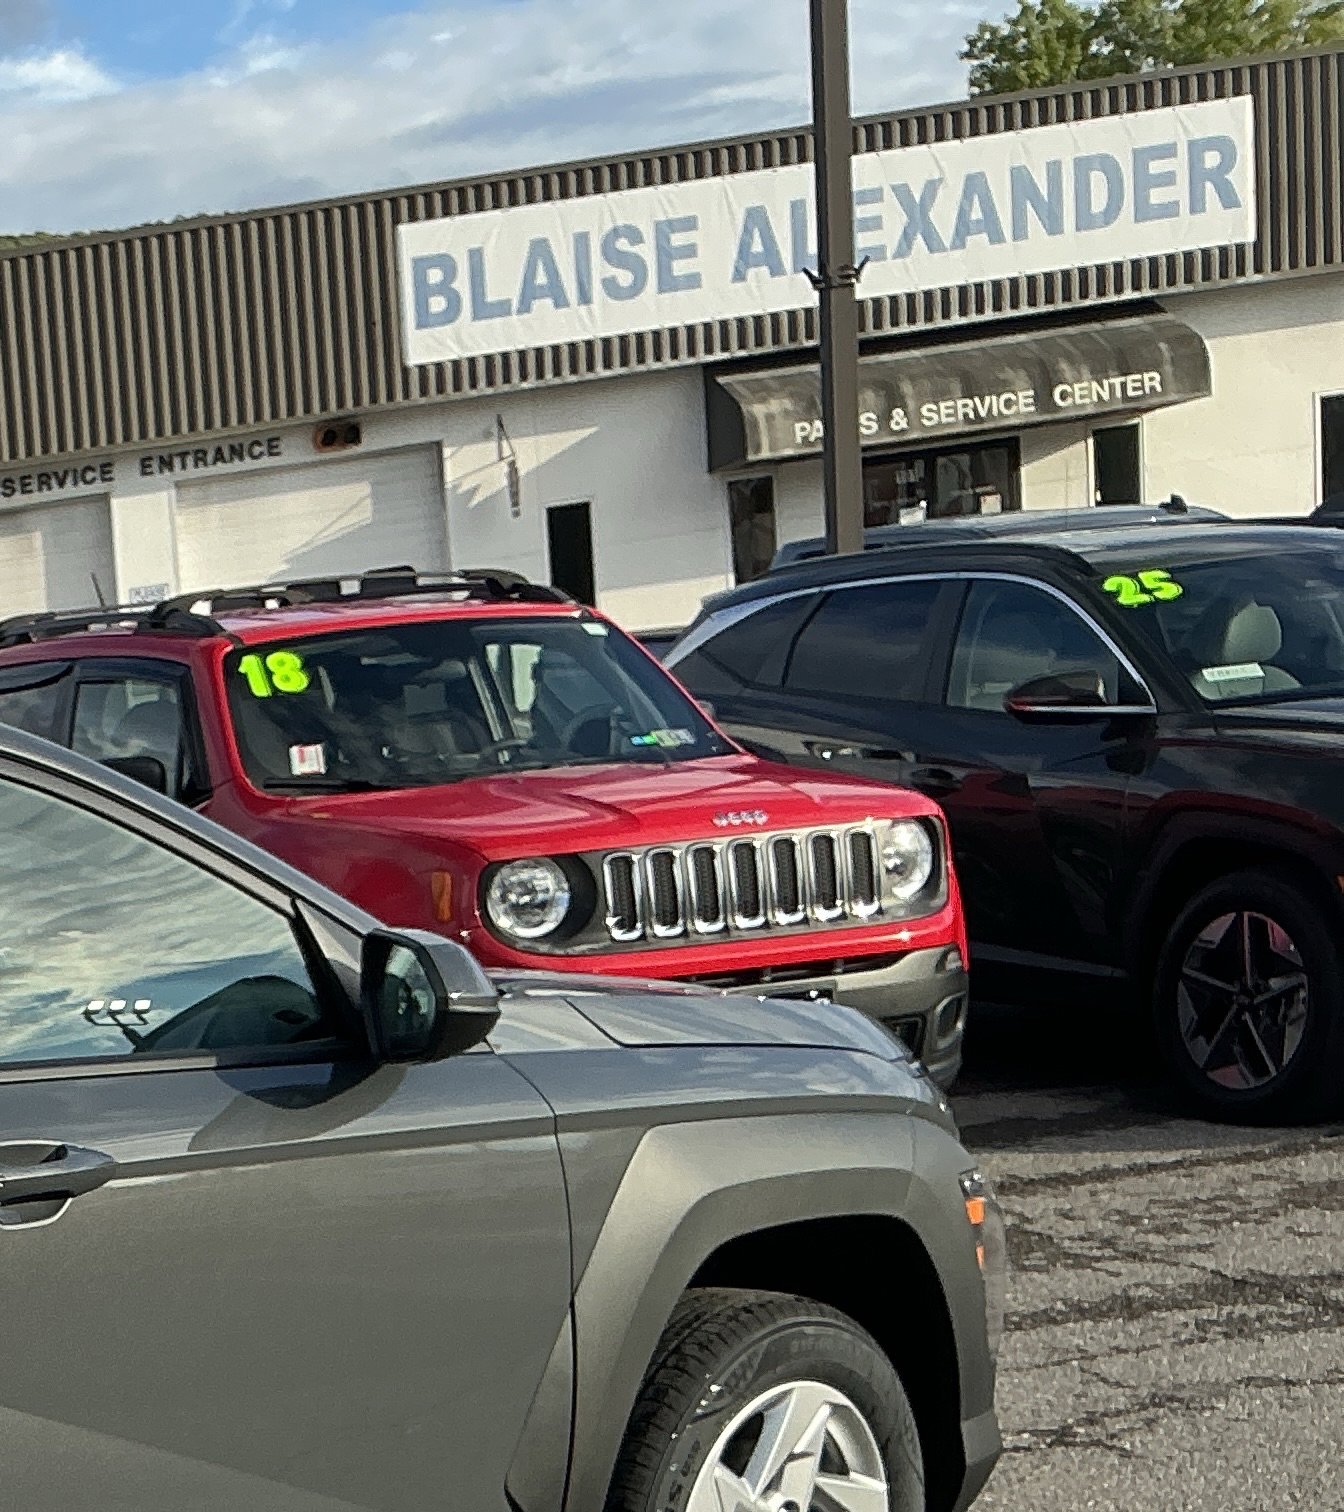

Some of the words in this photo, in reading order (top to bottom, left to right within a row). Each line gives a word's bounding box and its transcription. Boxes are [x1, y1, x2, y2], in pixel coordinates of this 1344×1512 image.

[412, 213, 703, 331] BLAISE
[731, 133, 1243, 285] ALEXANDER
[793, 411, 879, 445] PAS
[888, 407, 910, 432] &
[919, 388, 1036, 428] SERVICE
[1052, 371, 1163, 408] CENTER
[0, 461, 114, 498] SERVICE
[139, 436, 283, 477] ENTRANCE
[1102, 570, 1184, 607] 25
[238, 651, 309, 697] 18
